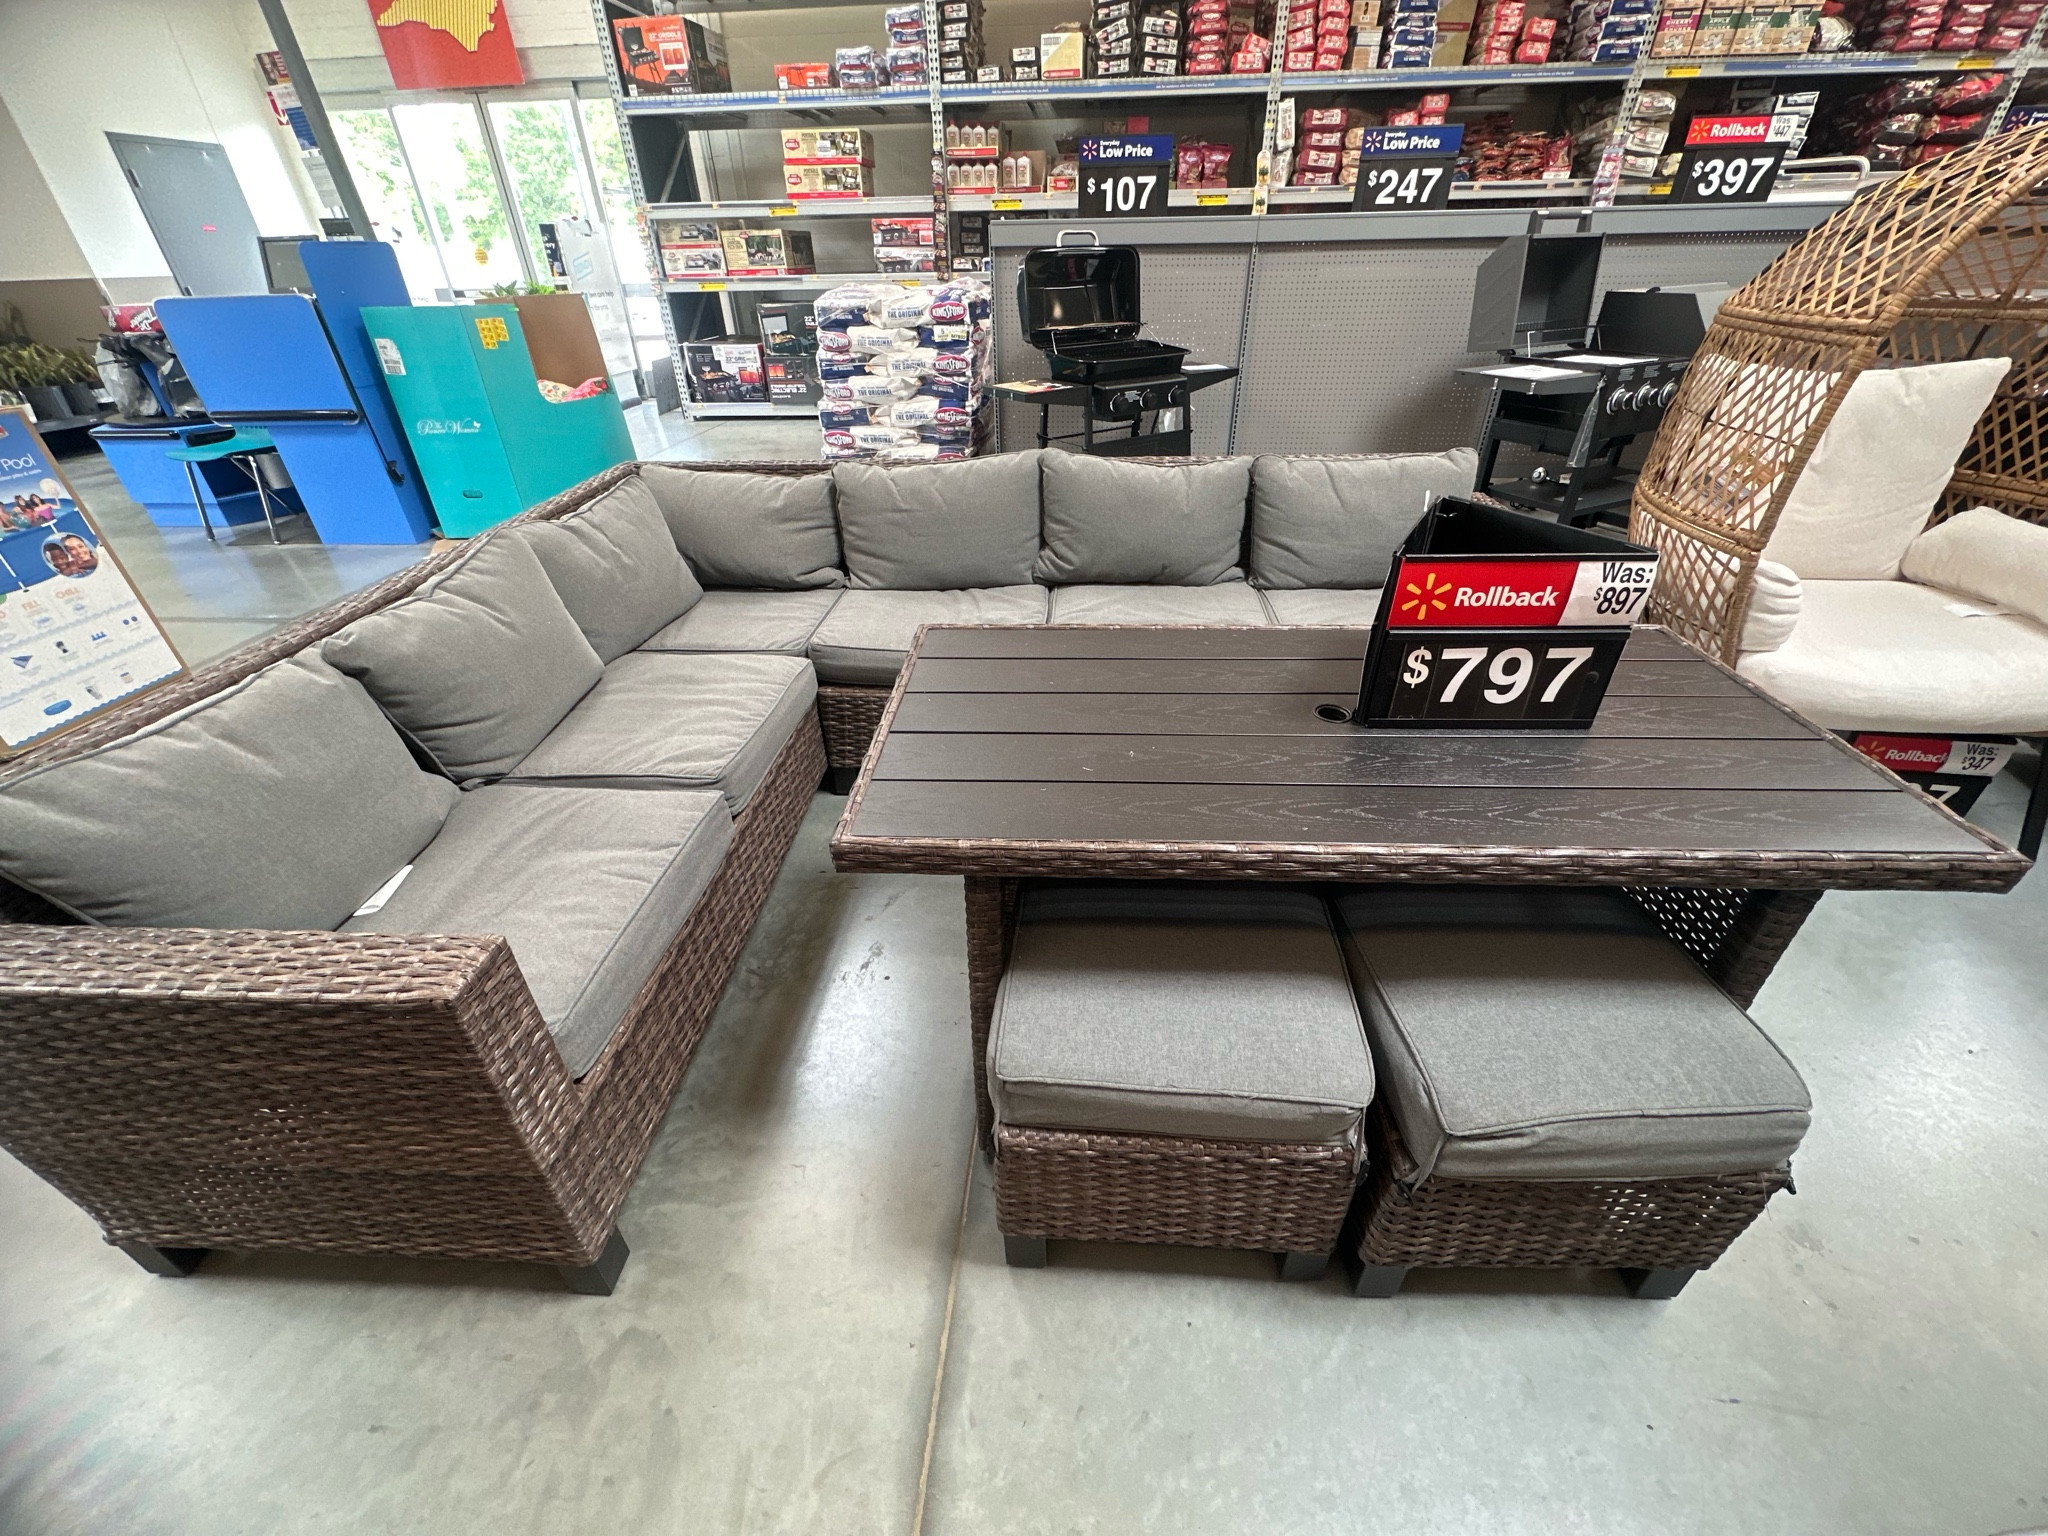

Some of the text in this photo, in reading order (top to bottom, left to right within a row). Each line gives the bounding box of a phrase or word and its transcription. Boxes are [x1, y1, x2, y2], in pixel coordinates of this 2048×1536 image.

[1709, 122, 1767, 137] Rollback
[1099, 144, 1154, 158] Low Price
[1383, 135, 1441, 150] Low Price
[1692, 157, 1775, 196] $397
[1086, 175, 1157, 212] $107
[1367, 168, 1443, 205] $247
[887, 309, 924, 318] THE ORIGINAL
[932, 304, 965, 318] KINGSFORD
[935, 359, 967, 371] KINGSFORD
[905, 413, 929, 421] ORIGINAL
[825, 434, 853, 446] KINGSFORD
[1, 453, 37, 471] Pool
[1602, 562, 1653, 585] Was:
[1453, 585, 1648, 615] Rollback $897
[1402, 645, 1595, 705] $797
[1885, 743, 2000, 764] Rollback Was:
[1961, 755, 1995, 772] $347
